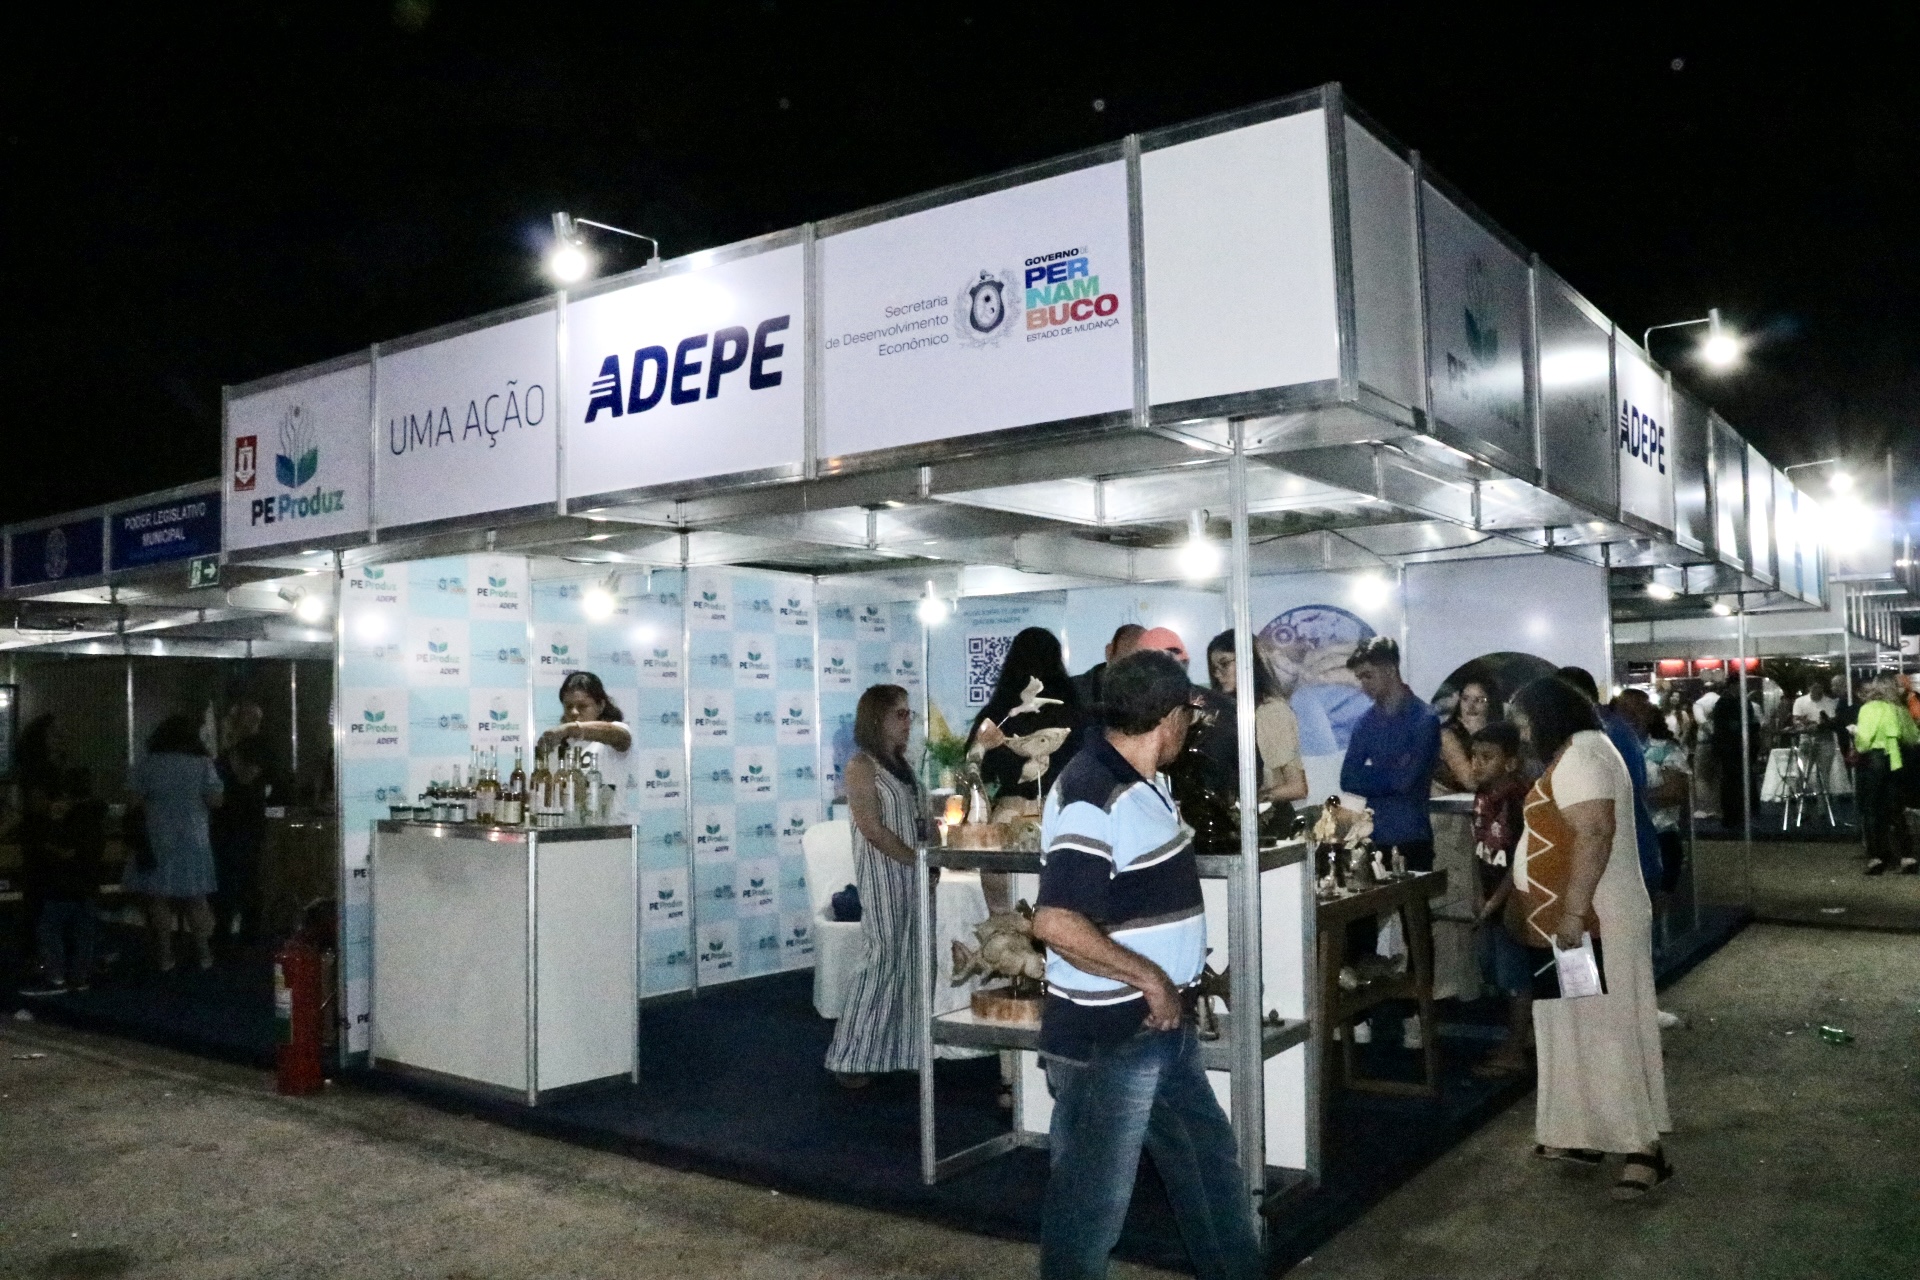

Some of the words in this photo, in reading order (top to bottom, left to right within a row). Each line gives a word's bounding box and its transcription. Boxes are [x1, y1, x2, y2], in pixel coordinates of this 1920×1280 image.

[1024, 247, 1079, 267] GOVERNO
[1024, 256, 1089, 290] PER
[1026, 275, 1100, 310] NAM
[885, 295, 949, 319] Secretaria
[1026, 293, 1119, 331] BUCO
[825, 337, 840, 350] de
[843, 314, 949, 346] Desenvolvimento
[1026, 329, 1060, 343] ESTADO
[1060, 326, 1073, 336] DE
[1074, 318, 1120, 333] MUDANÇA
[878, 333, 949, 357] Econômico
[584, 314, 791, 424] ADEPE
[389, 406, 454, 456] UMA
[462, 380, 545, 449] AÇÃO
[1620, 398, 1666, 476] ADEPE
[124, 513, 152, 531] PODER
[153, 501, 207, 526] LEGISLATIVO
[251, 496, 276, 527] PE
[278, 486, 345, 522] Produz
[142, 527, 186, 547] MUNICIPAL
[350, 579, 363, 589] PE
[365, 579, 397, 591] Produz
[477, 587, 489, 597] PE
[489, 588, 518, 599] Produz
[416, 653, 429, 663] PE
[541, 655, 552, 665] PE
[351, 723, 365, 734] PE
[366, 723, 398, 734] Produz
[478, 722, 490, 731] PE
[491, 722, 520, 731] Produz
[353, 868, 367, 878] PE
[357, 1013, 370, 1024] PE
